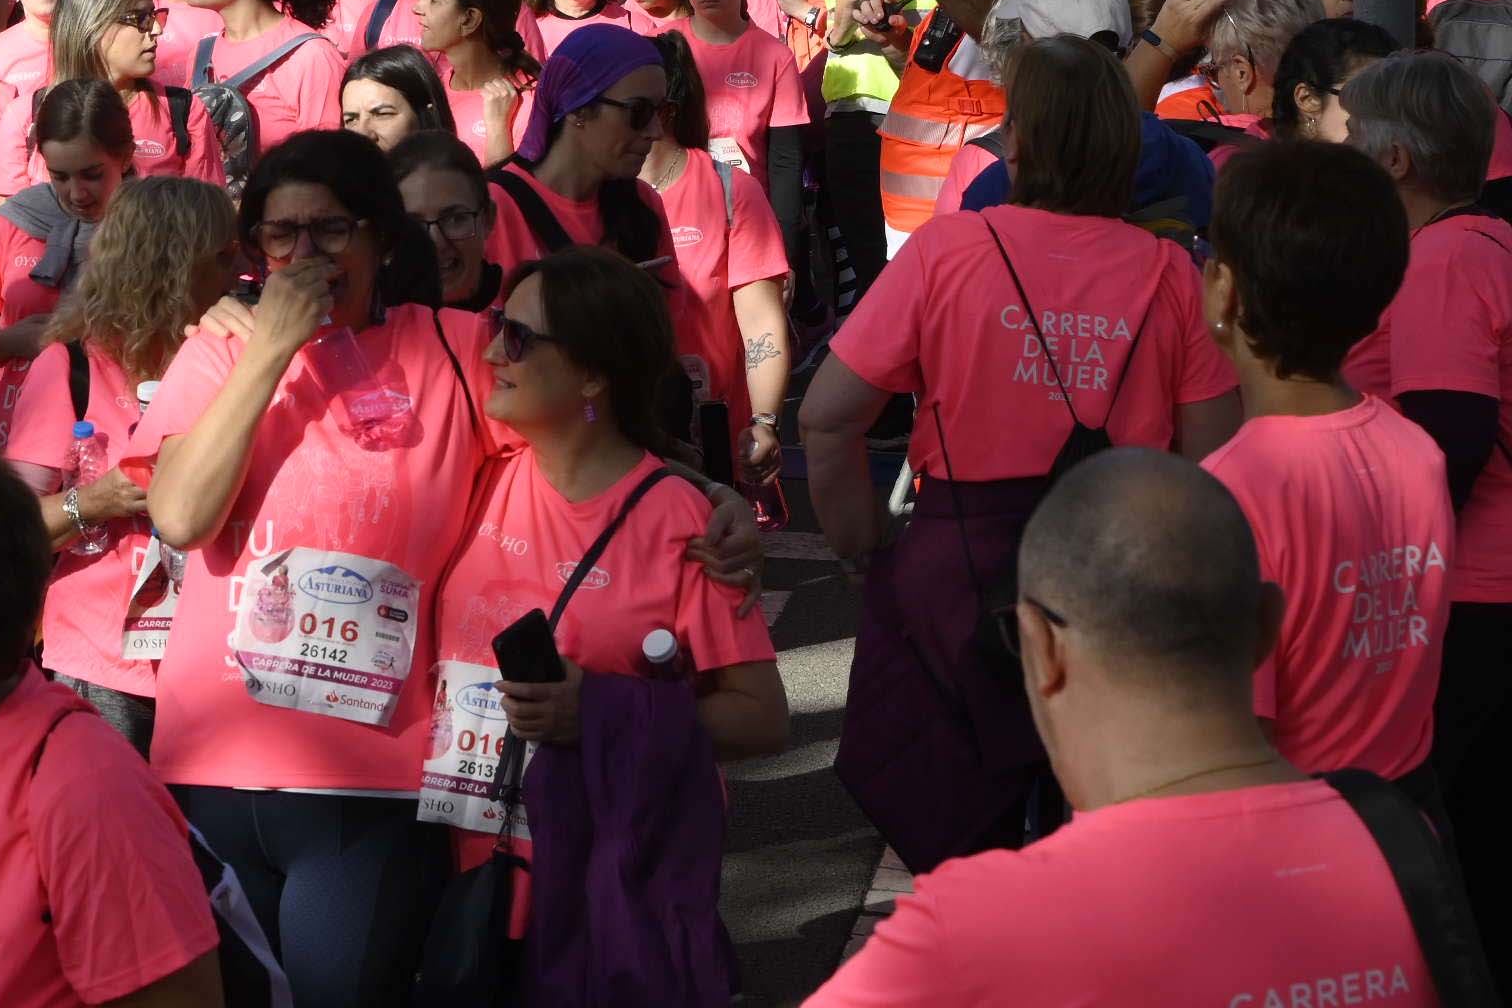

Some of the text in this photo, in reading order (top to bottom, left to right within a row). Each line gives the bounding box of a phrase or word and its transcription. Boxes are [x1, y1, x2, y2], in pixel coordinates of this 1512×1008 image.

[1001, 305, 1132, 341] CARRERA
[1024, 334, 1105, 365] DE LA
[1013, 359, 1110, 391] MUJER
[478, 522, 529, 556] OYHO
[1334, 541, 1447, 594] CARRERA
[305, 576, 368, 600] ASTURIANA
[1353, 580, 1419, 623] DE LA
[299, 612, 360, 643] 016
[1342, 615, 1430, 659] MUJER
[300, 643, 348, 664] 26142
[252, 657, 299, 673] CARRERA
[302, 665, 316, 676] DE
[317, 668, 331, 679] LA
[333, 671, 368, 685] MUJER
[246, 678, 296, 698] OYSHO
[459, 782, 473, 792] DE
[474, 784, 488, 794] LA
[422, 798, 454, 814] SHO
